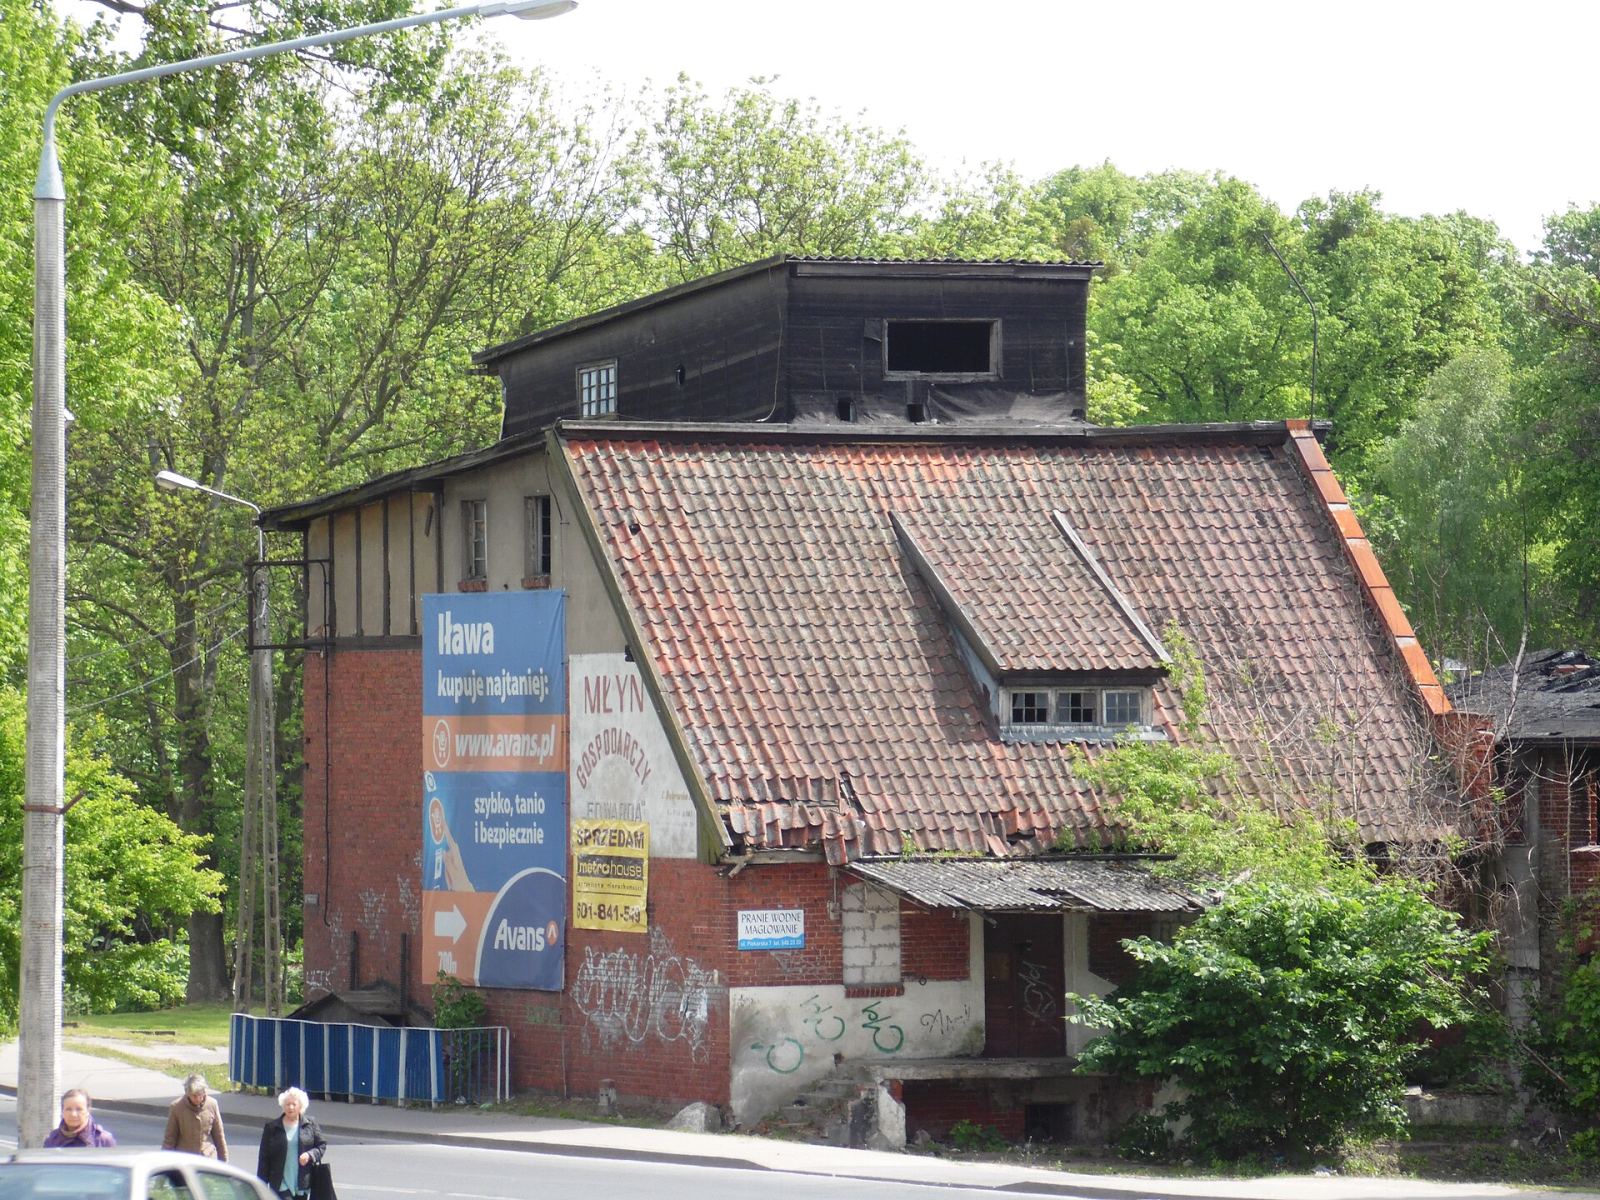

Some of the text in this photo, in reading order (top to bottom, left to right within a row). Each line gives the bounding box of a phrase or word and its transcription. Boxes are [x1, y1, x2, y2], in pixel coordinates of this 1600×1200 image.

[438, 611, 494, 655] Iława
[437, 667, 549, 703] kupuje najtaniej:
[584, 675, 644, 714] MŁYN
[455, 724, 555, 765] www.avans.pl
[576, 727, 651, 789] GOSPODARCZY
[474, 791, 545, 819] szybko, tanio
[474, 820, 544, 849] i bezpiecznie
[576, 828, 644, 848] SPRZEDAM
[579, 860, 642, 877] metrohouse
[741, 911, 801, 923] PRANIE WODNE
[744, 923, 798, 935] MAGLOWANIE
[494, 918, 545, 951] Avans
